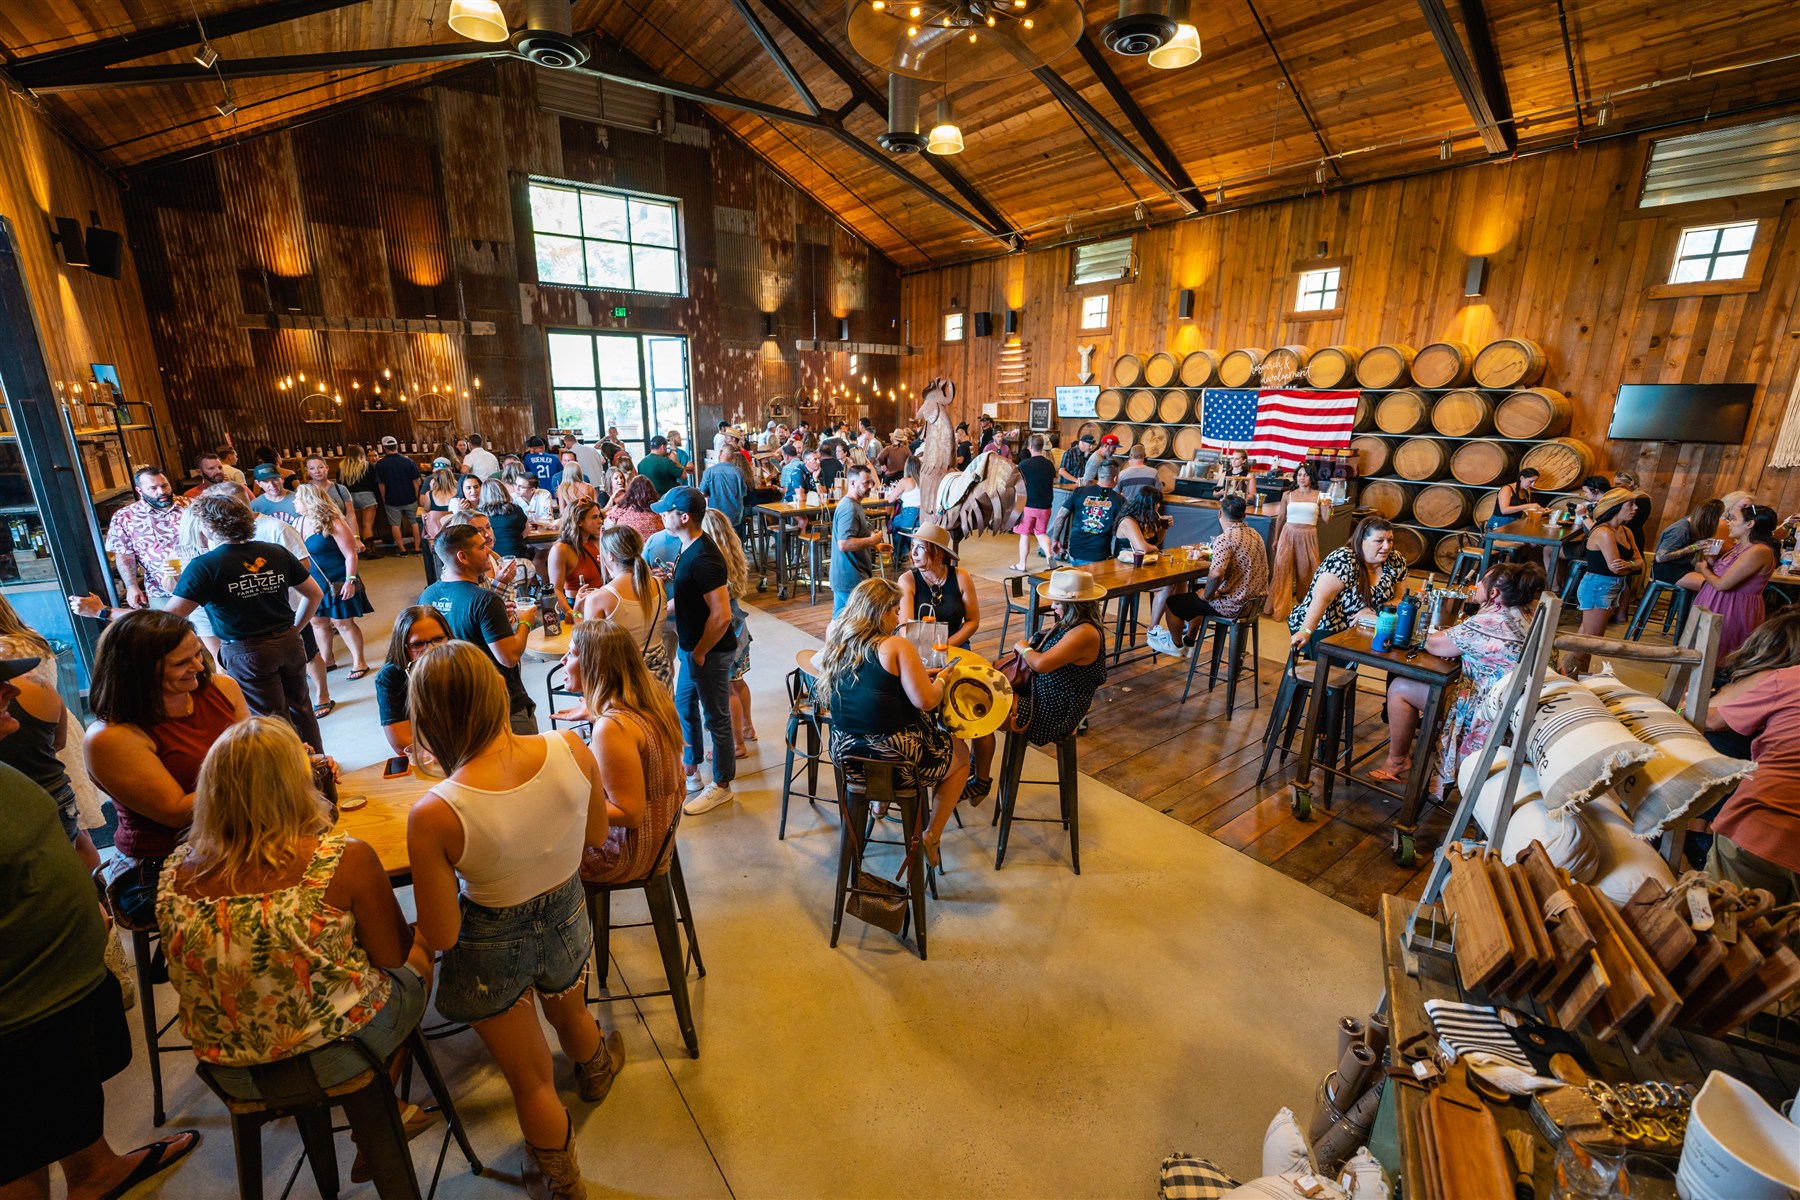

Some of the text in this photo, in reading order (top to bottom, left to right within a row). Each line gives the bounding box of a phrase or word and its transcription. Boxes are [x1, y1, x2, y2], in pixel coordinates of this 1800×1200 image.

[1261, 364, 1315, 385] development
[536, 464, 550, 479] 21
[228, 574, 285, 593] PELTZER
